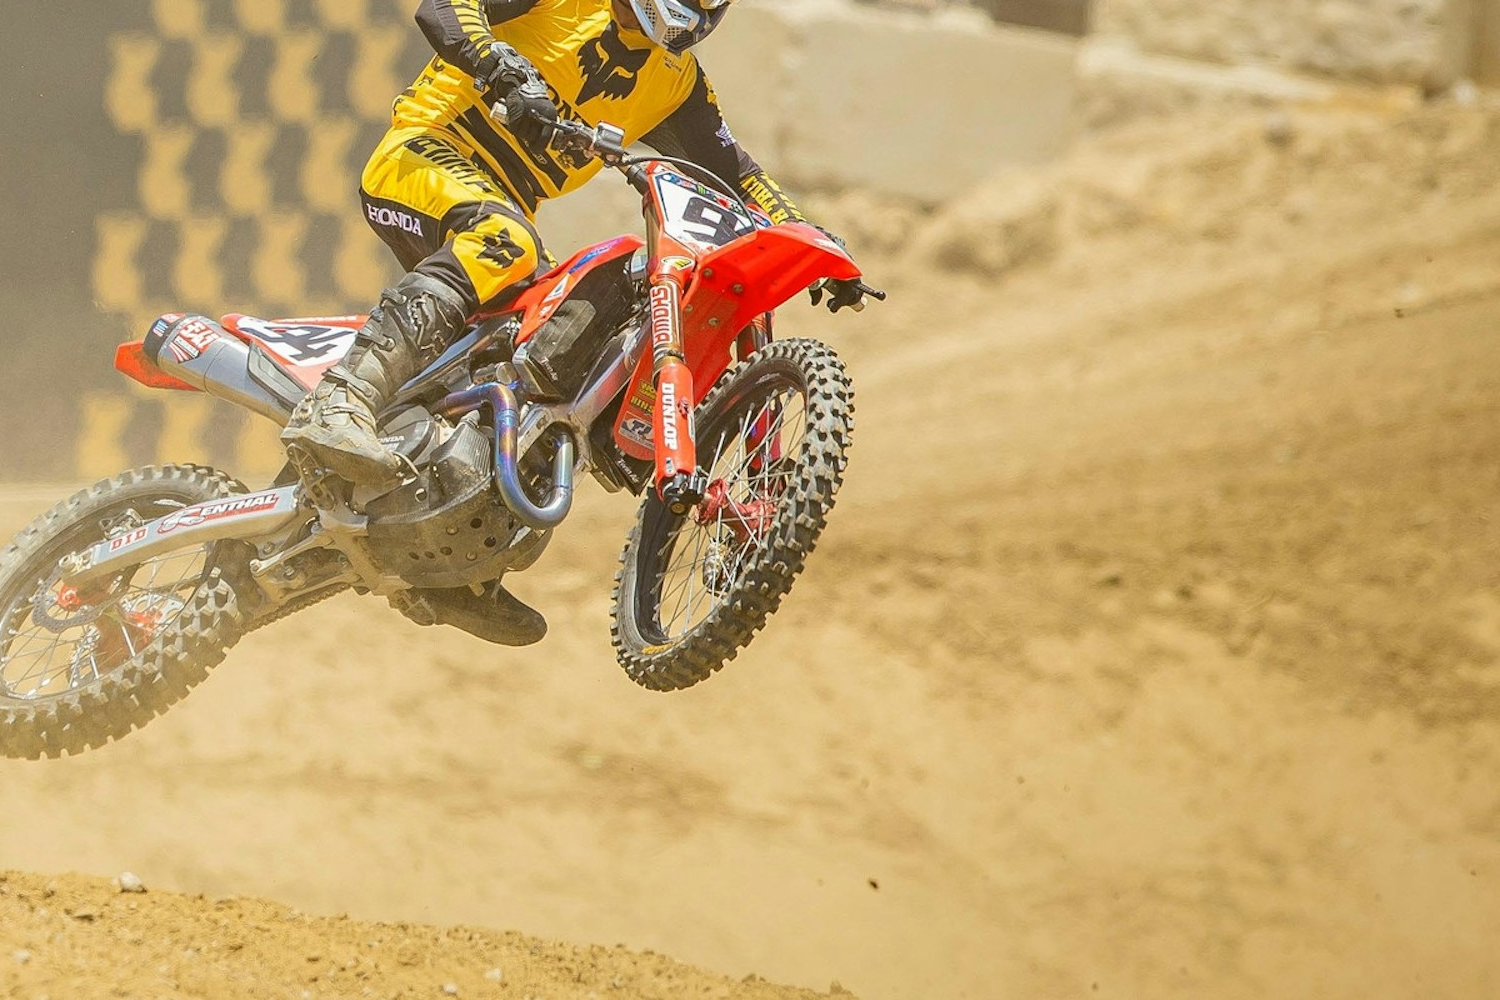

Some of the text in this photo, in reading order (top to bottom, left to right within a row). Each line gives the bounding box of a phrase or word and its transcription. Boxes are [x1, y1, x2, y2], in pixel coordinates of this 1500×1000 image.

[366, 203, 423, 237] HONDA
[650, 285, 672, 345] SHOWA
[661, 382, 678, 450] DUNLOP
